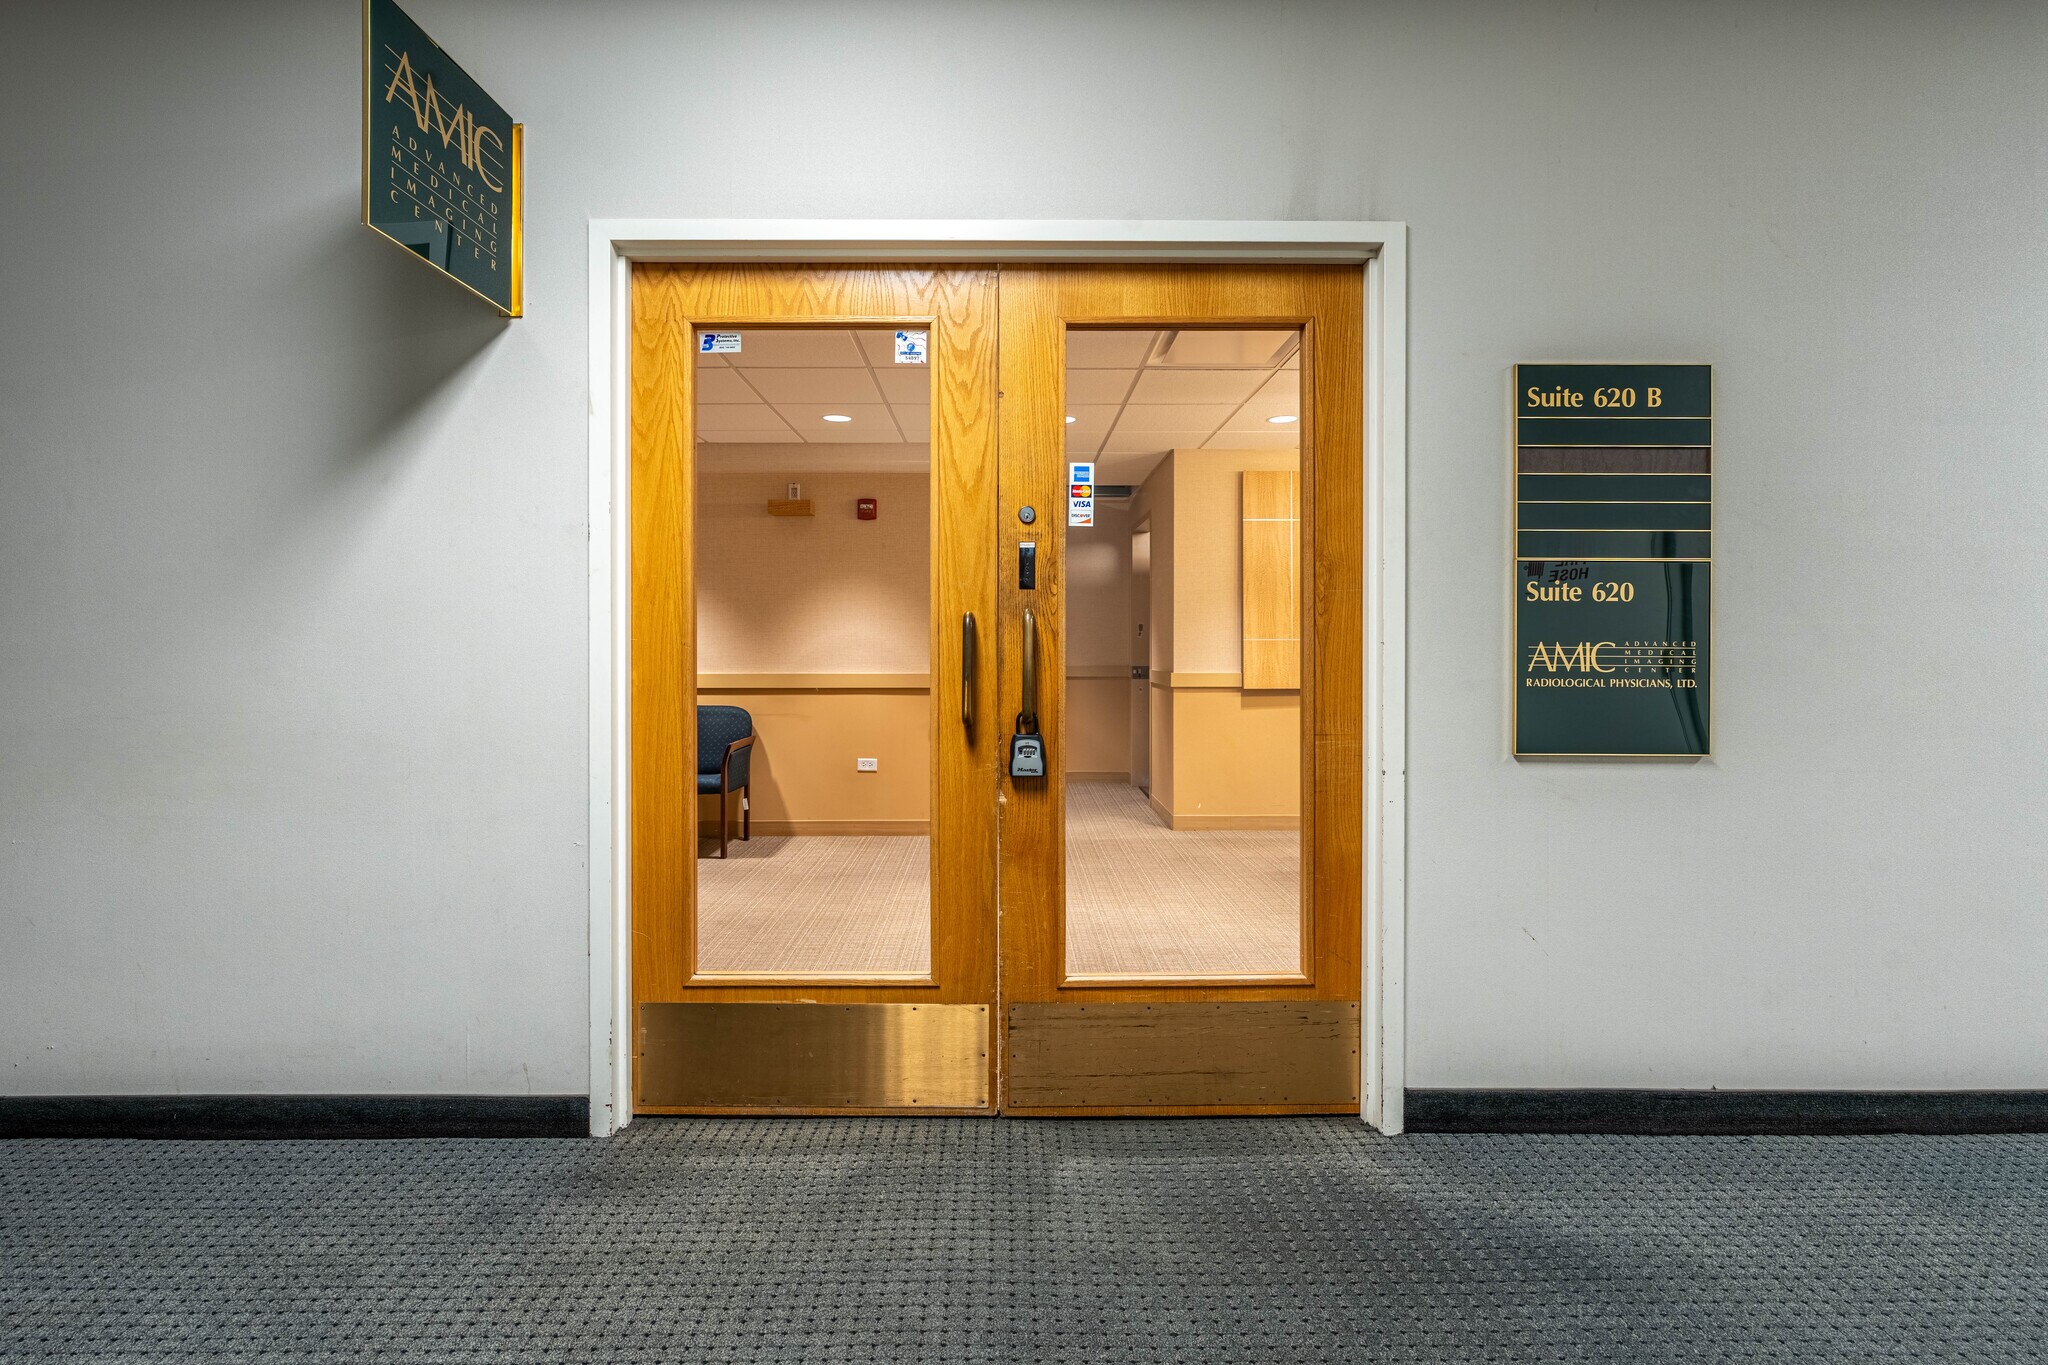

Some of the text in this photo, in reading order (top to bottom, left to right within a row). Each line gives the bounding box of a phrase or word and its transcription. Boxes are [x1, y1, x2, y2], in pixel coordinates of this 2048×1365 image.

[385, 51, 504, 193] AMIC
[391, 146, 498, 235] MEDICAL
[391, 167, 498, 253] IMAGING
[392, 125, 498, 215] ADVANCED
[390, 190, 497, 271] CENTER
[1527, 385, 1662, 408] Suite 620 B
[1526, 580, 1635, 602] Suite 620
[1526, 678, 1698, 689] RADIOLOGICAL PHYSICIANS, LTD.
[1527, 641, 1616, 673] AMIC
